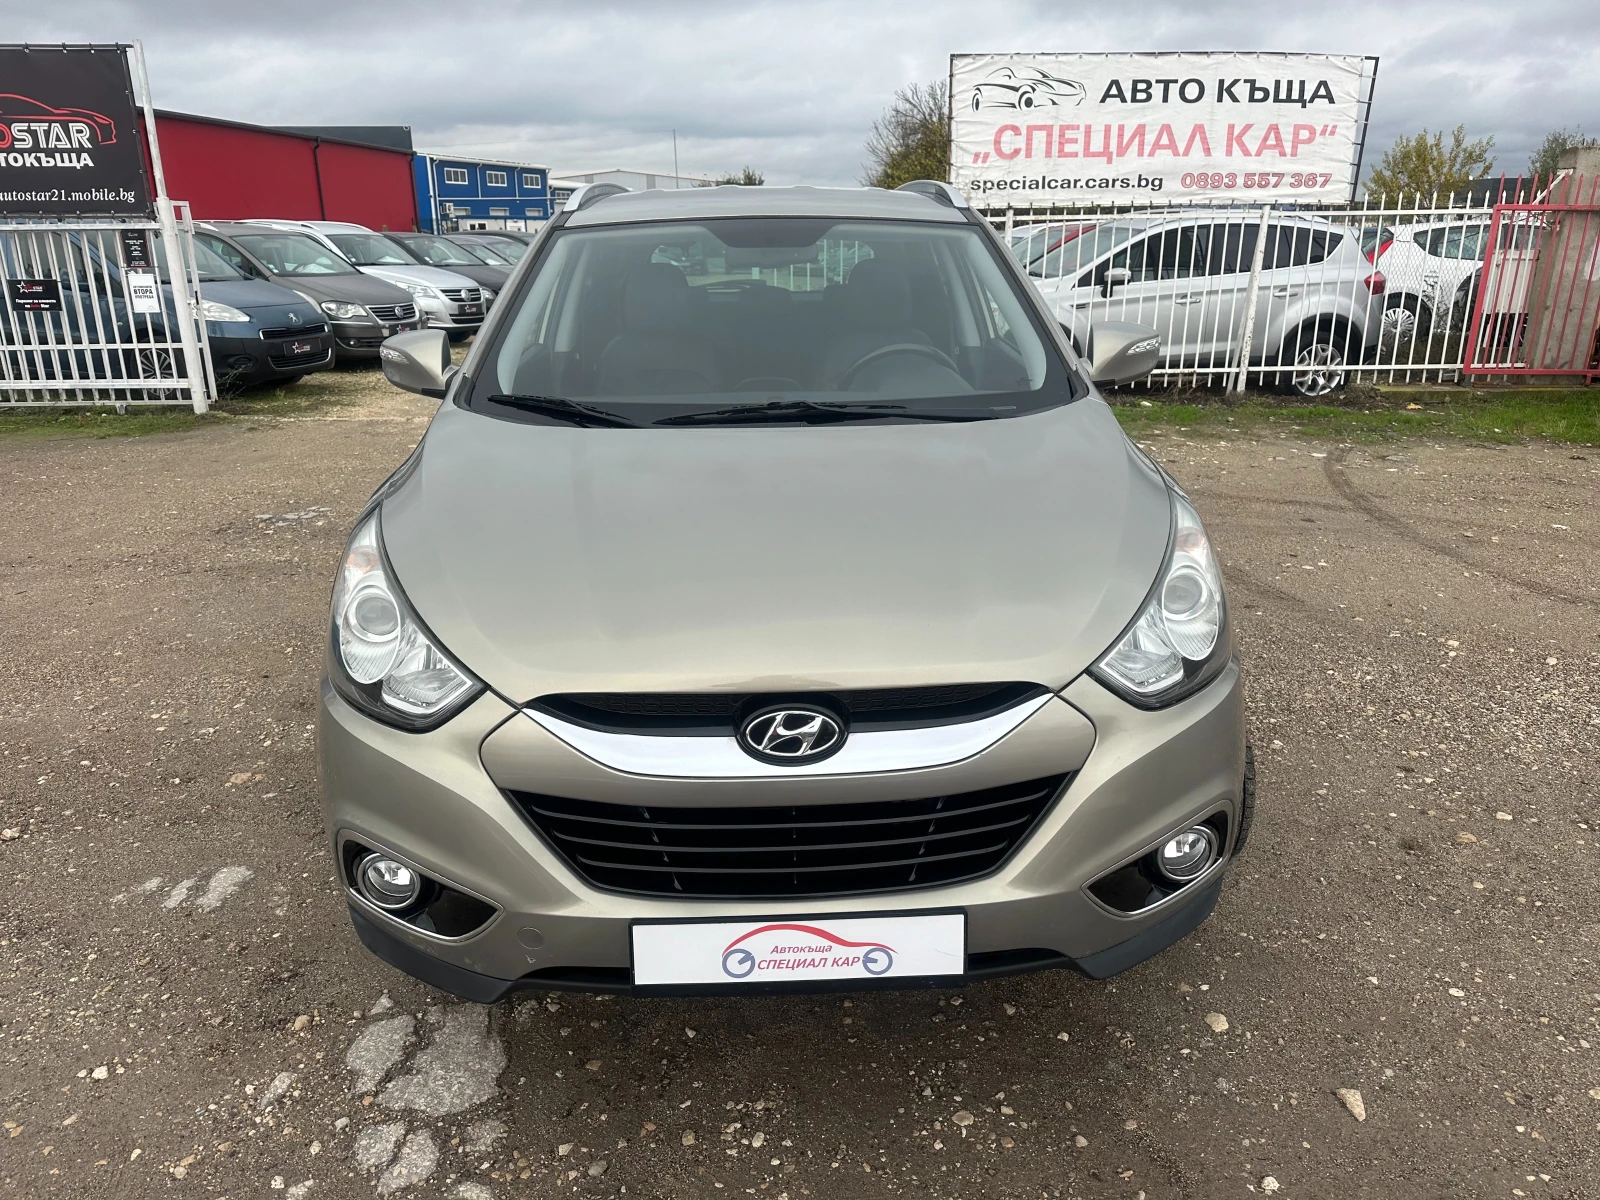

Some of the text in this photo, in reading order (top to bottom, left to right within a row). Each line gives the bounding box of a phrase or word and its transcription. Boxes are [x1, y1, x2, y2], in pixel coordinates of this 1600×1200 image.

[1099, 78, 1336, 109] АВТО КЪЩА
[970, 173, 1164, 194] specialcar.cars.bg
[1180, 172, 1333, 189] 0893 557 367
[770, 944, 833, 955] Автокъща
[757, 956, 861, 971] СПЕЦИАЛ КАР
